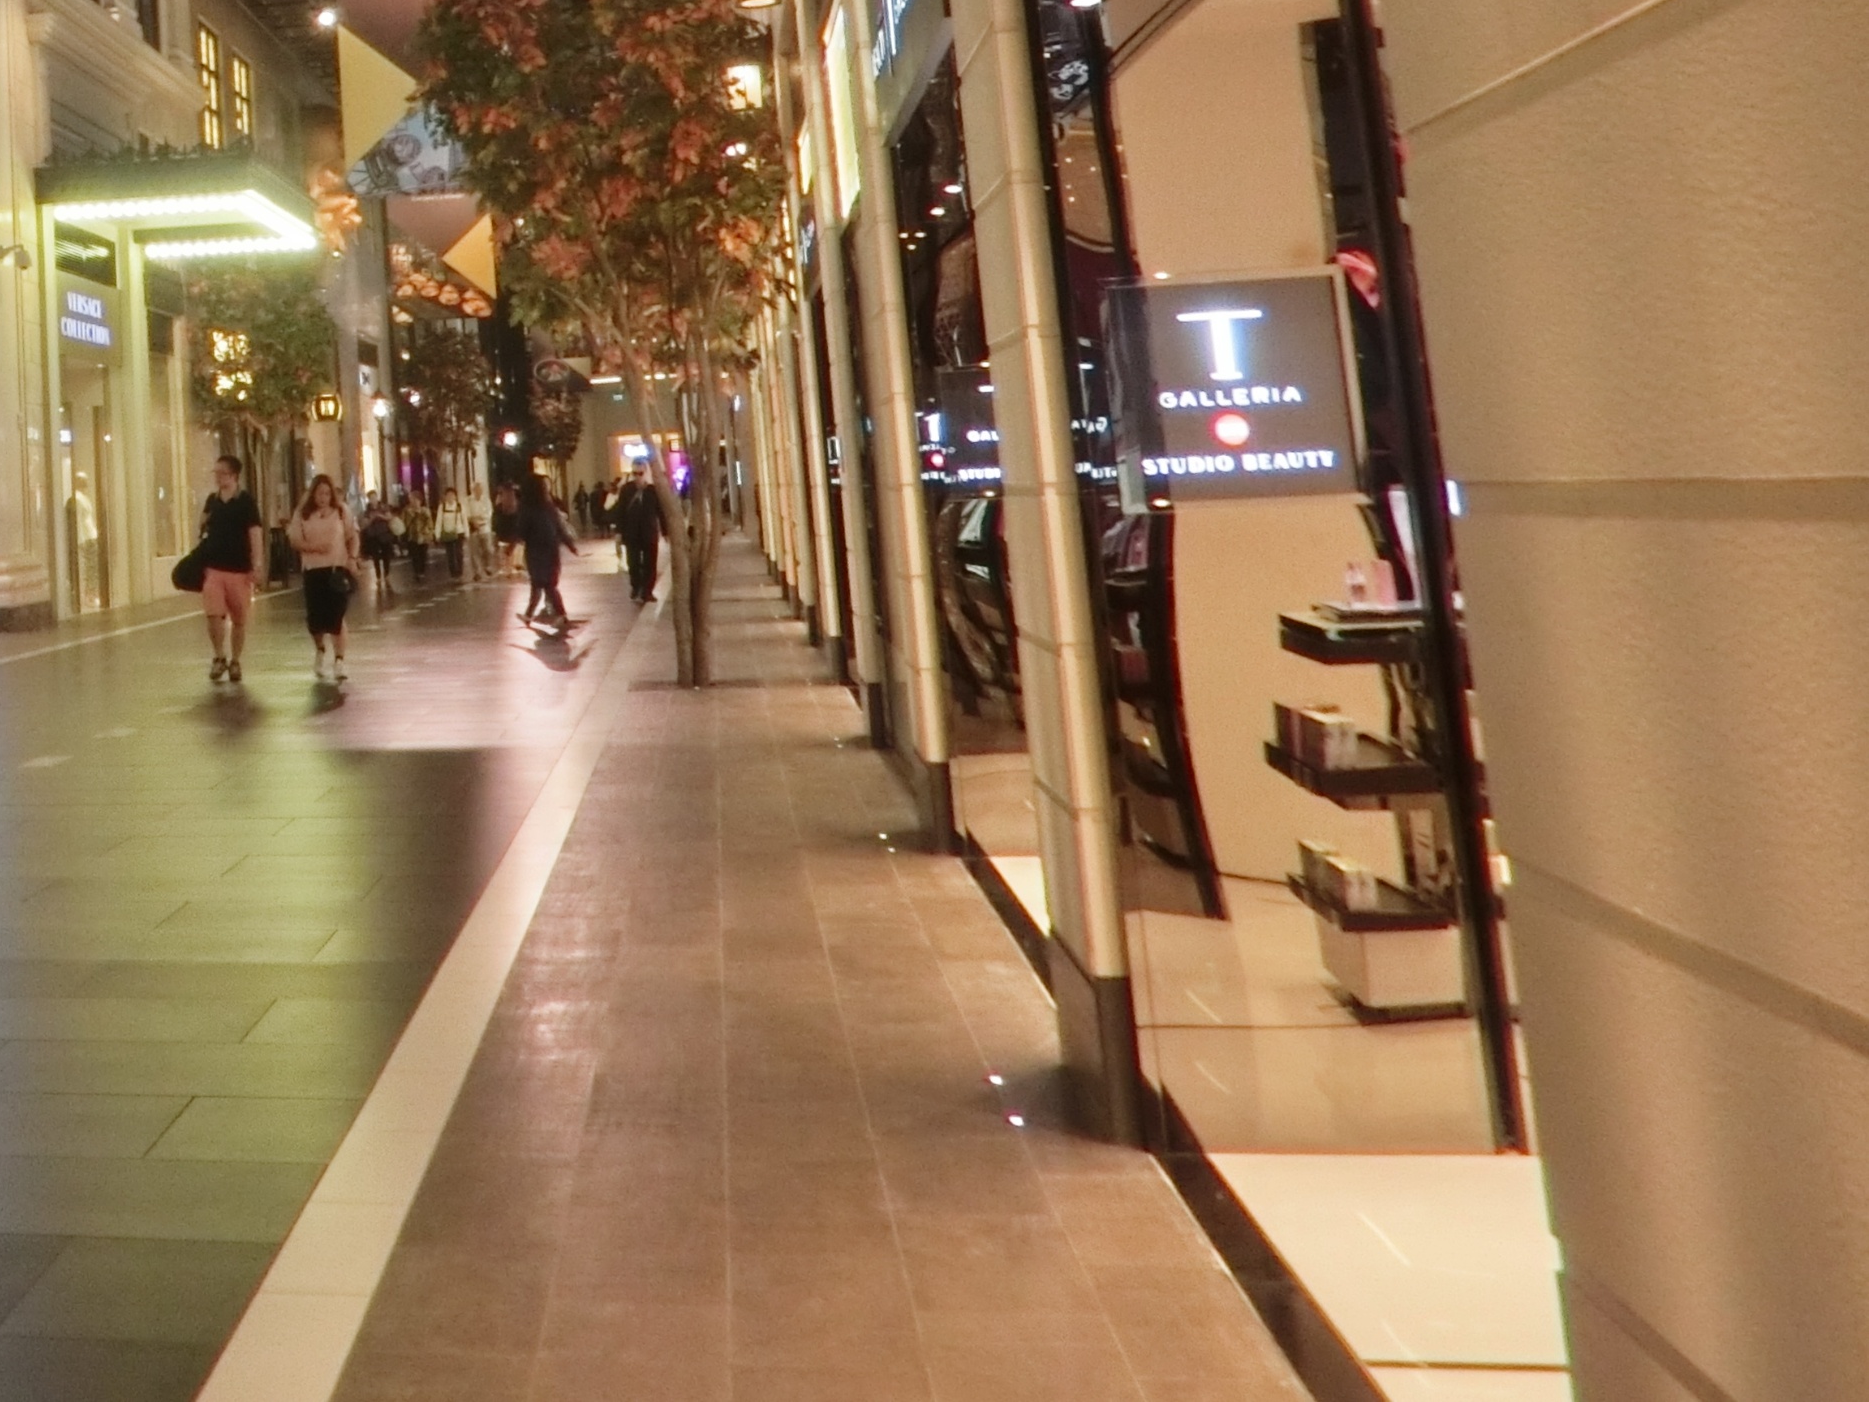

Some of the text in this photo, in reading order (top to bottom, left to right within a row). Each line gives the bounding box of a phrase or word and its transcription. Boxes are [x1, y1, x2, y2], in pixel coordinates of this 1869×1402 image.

[1176, 309, 1263, 380] T
[1158, 386, 1302, 409] GALLERIA
[1142, 454, 1235, 476] STUDIO
[1241, 450, 1335, 472] BEAUTY
